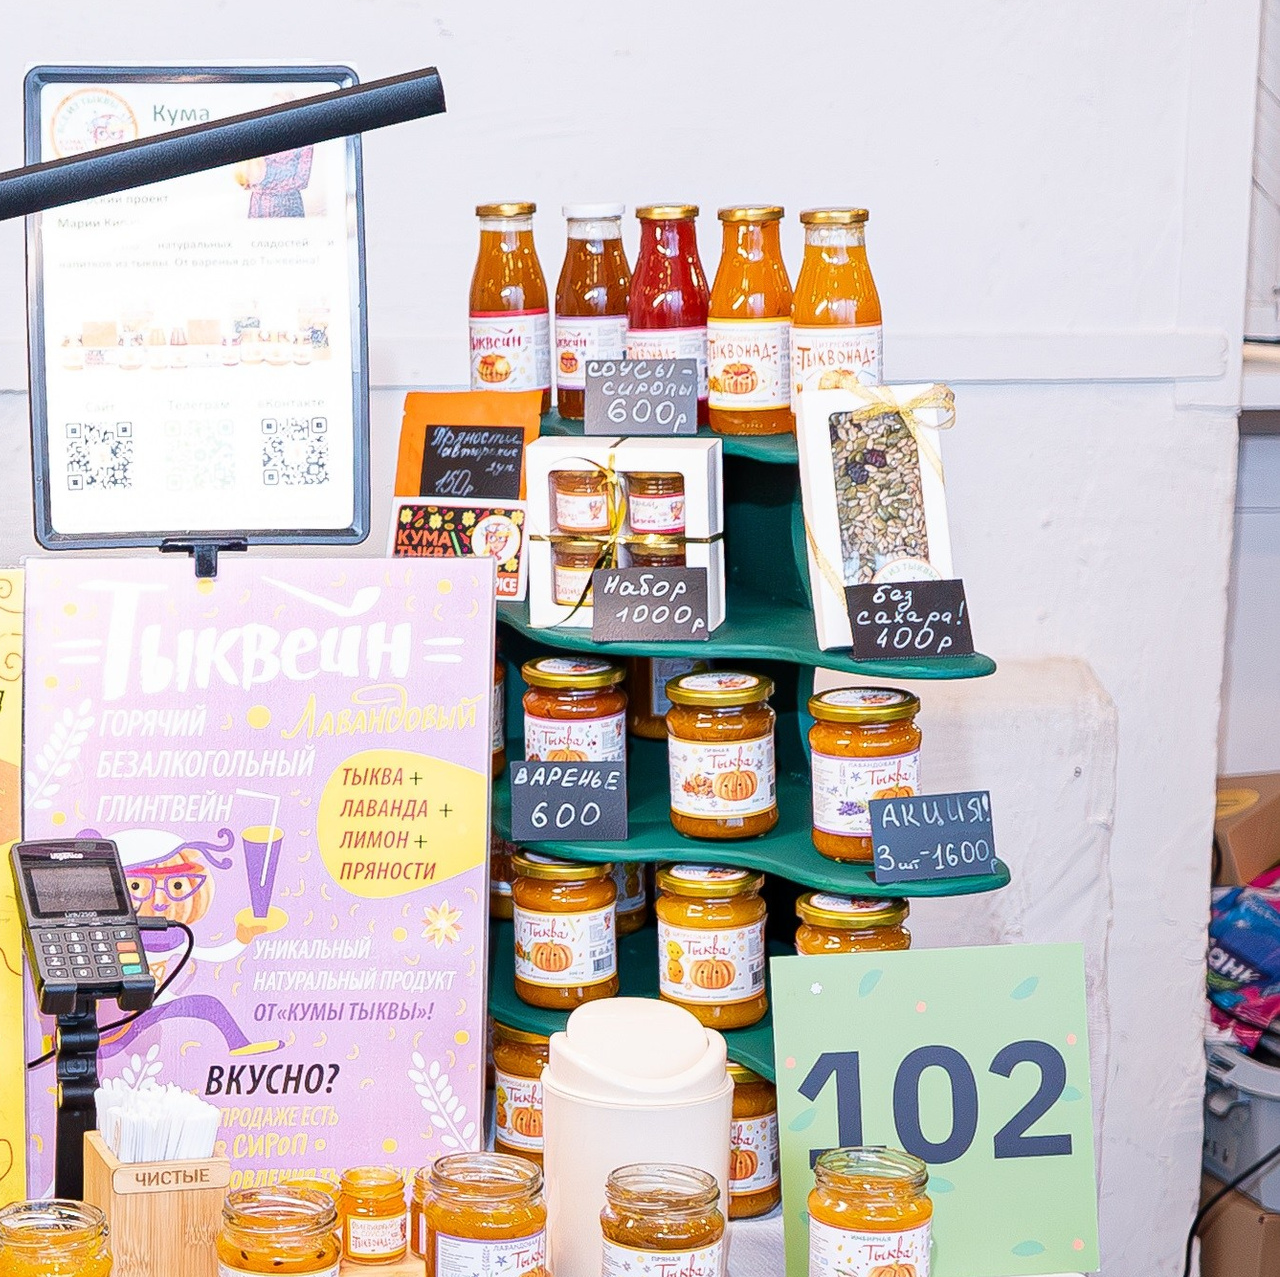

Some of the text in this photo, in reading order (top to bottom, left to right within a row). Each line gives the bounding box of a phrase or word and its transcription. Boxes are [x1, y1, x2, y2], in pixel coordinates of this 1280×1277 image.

[153, 104, 210, 125] Кума
[57, 216, 99, 232] Марии
[250, 233, 309, 251] сладостей
[397, 529, 452, 547] КУМА
[604, 575, 687, 601] Набор
[873, 585, 913, 608] без
[77, 576, 412, 701] Тыквейн
[98, 703, 207, 737] ГОРЯЧИЙ
[282, 684, 485, 740] Лавандовый
[540, 725, 583, 747] Тыква
[96, 745, 316, 778] БЕЗАЛКОГОЛЬНЫЙ
[707, 746, 754, 769] Тыква
[342, 767, 404, 786] ТЫКВА
[514, 766, 620, 791] ВАРЕНЬЕ
[865, 759, 912, 785] Тыква
[96, 788, 234, 823] ГЛИНТВЕЙН
[340, 799, 428, 819] ЛАВАНДА
[531, 801, 601, 829] 600
[339, 830, 409, 849] ЛИМОН
[339, 862, 437, 881] ПРЯНОСТИ
[526, 918, 569, 939] Тыква
[253, 936, 372, 960] УНИКАЛЬНЫЙ
[683, 934, 731, 956] Тыква
[253, 966, 457, 992] НАТУРАЛЬНЫЙ ПРОДУКТ
[349, 1001, 435, 1022] ТЫКВЫ»!
[205, 1063, 341, 1095] ВКУСНО?
[798, 1040, 1072, 1169] 102
[300, 1106, 340, 1127] ЕСТЬ
[232, 1132, 309, 1159] СИРОП
[134, 1168, 210, 1186] ЧИСТЫЕ
[862, 1236, 913, 1261] Тыква
